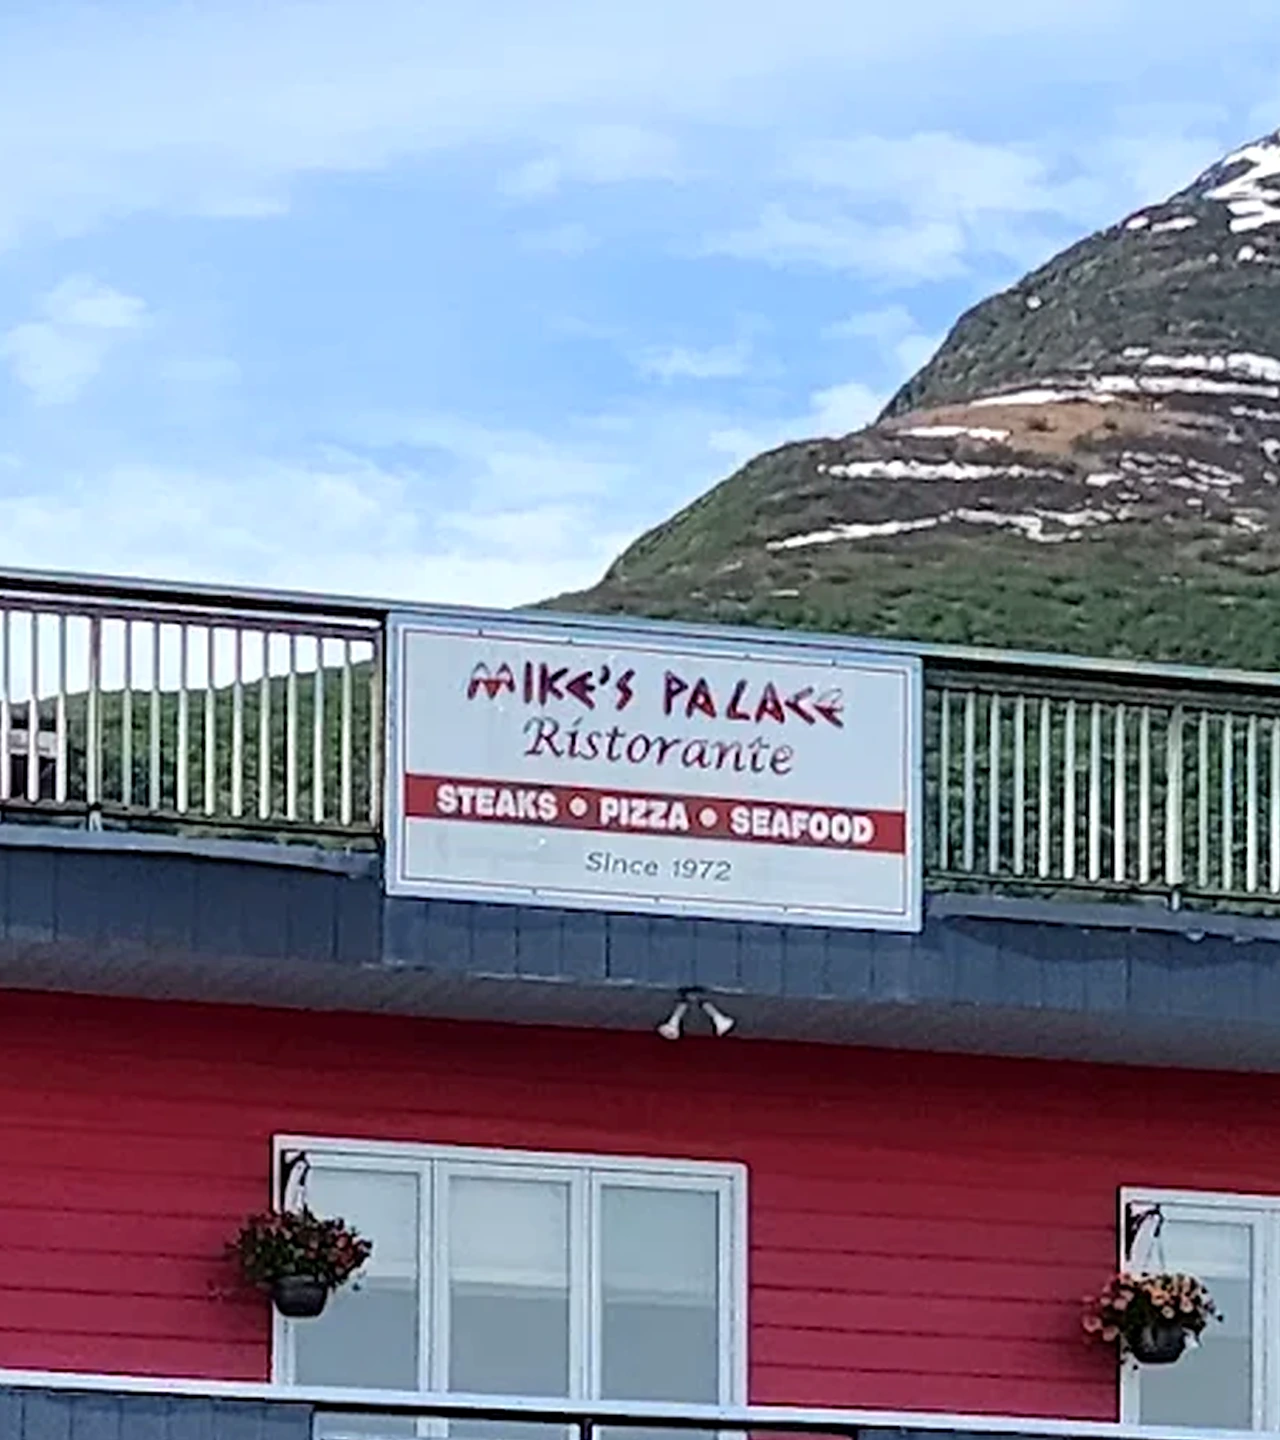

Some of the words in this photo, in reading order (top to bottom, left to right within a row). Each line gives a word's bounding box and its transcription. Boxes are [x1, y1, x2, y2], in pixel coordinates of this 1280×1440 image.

[466, 661, 635, 709] MIKE'S
[663, 670, 845, 728] PALACE
[523, 716, 795, 775] Ristorante
[436, 784, 558, 820] STEAKS
[599, 796, 689, 831] PIZZA
[730, 808, 875, 844] SEAFOOD
[585, 850, 659, 877] Since
[672, 857, 732, 881] 1972
